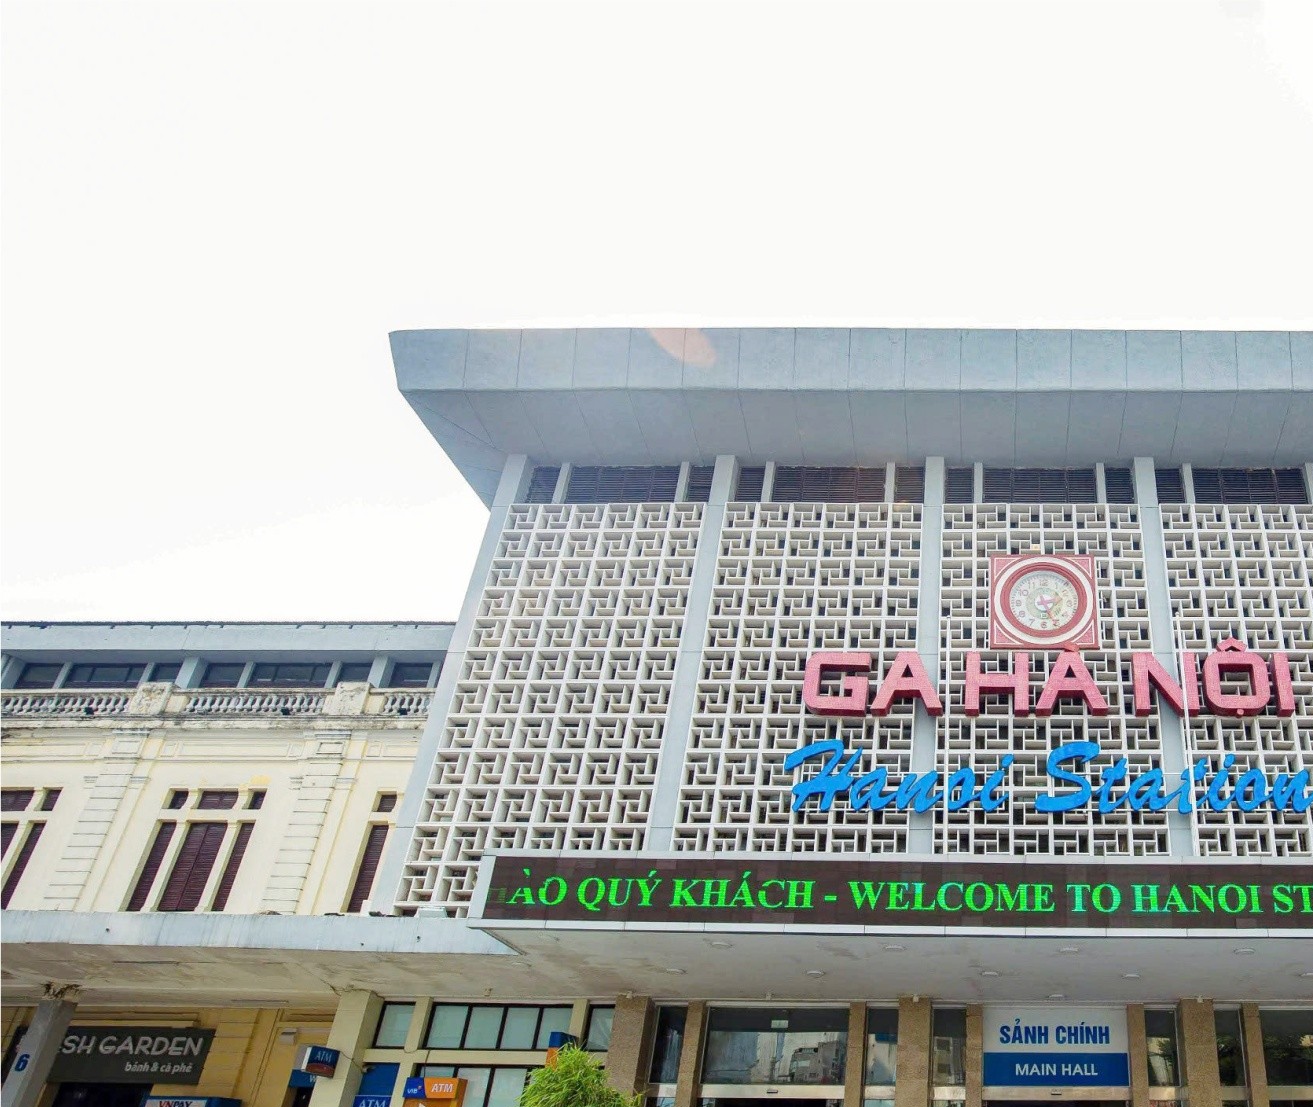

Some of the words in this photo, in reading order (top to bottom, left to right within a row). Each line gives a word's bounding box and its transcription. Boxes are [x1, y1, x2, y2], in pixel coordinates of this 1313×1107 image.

[804, 652, 943, 718] GA
[964, 642, 1109, 718] HÀ
[1132, 637, 1296, 718] NỘI
[784, 738, 1016, 815] Hanoi
[490, 868, 569, 906] ÀO
[576, 870, 662, 911] QUÝ
[670, 871, 814, 908] KHÁCH
[848, 881, 1055, 912] WELCOME
[1066, 883, 1121, 912] TO
[1132, 883, 1261, 913] HANOI
[1000, 1018, 1048, 1045] SẢNH
[1056, 1021, 1110, 1045] CHÍNH
[99, 1036, 203, 1056] GARDEN
[15, 1053, 30, 1071] 6
[315, 1051, 332, 1061] ATM
[125, 1061, 149, 1072] bánh
[1015, 1063, 1057, 1077] MAIN
[1061, 1063, 1099, 1077] HALL
[431, 1083, 454, 1093] ATM
